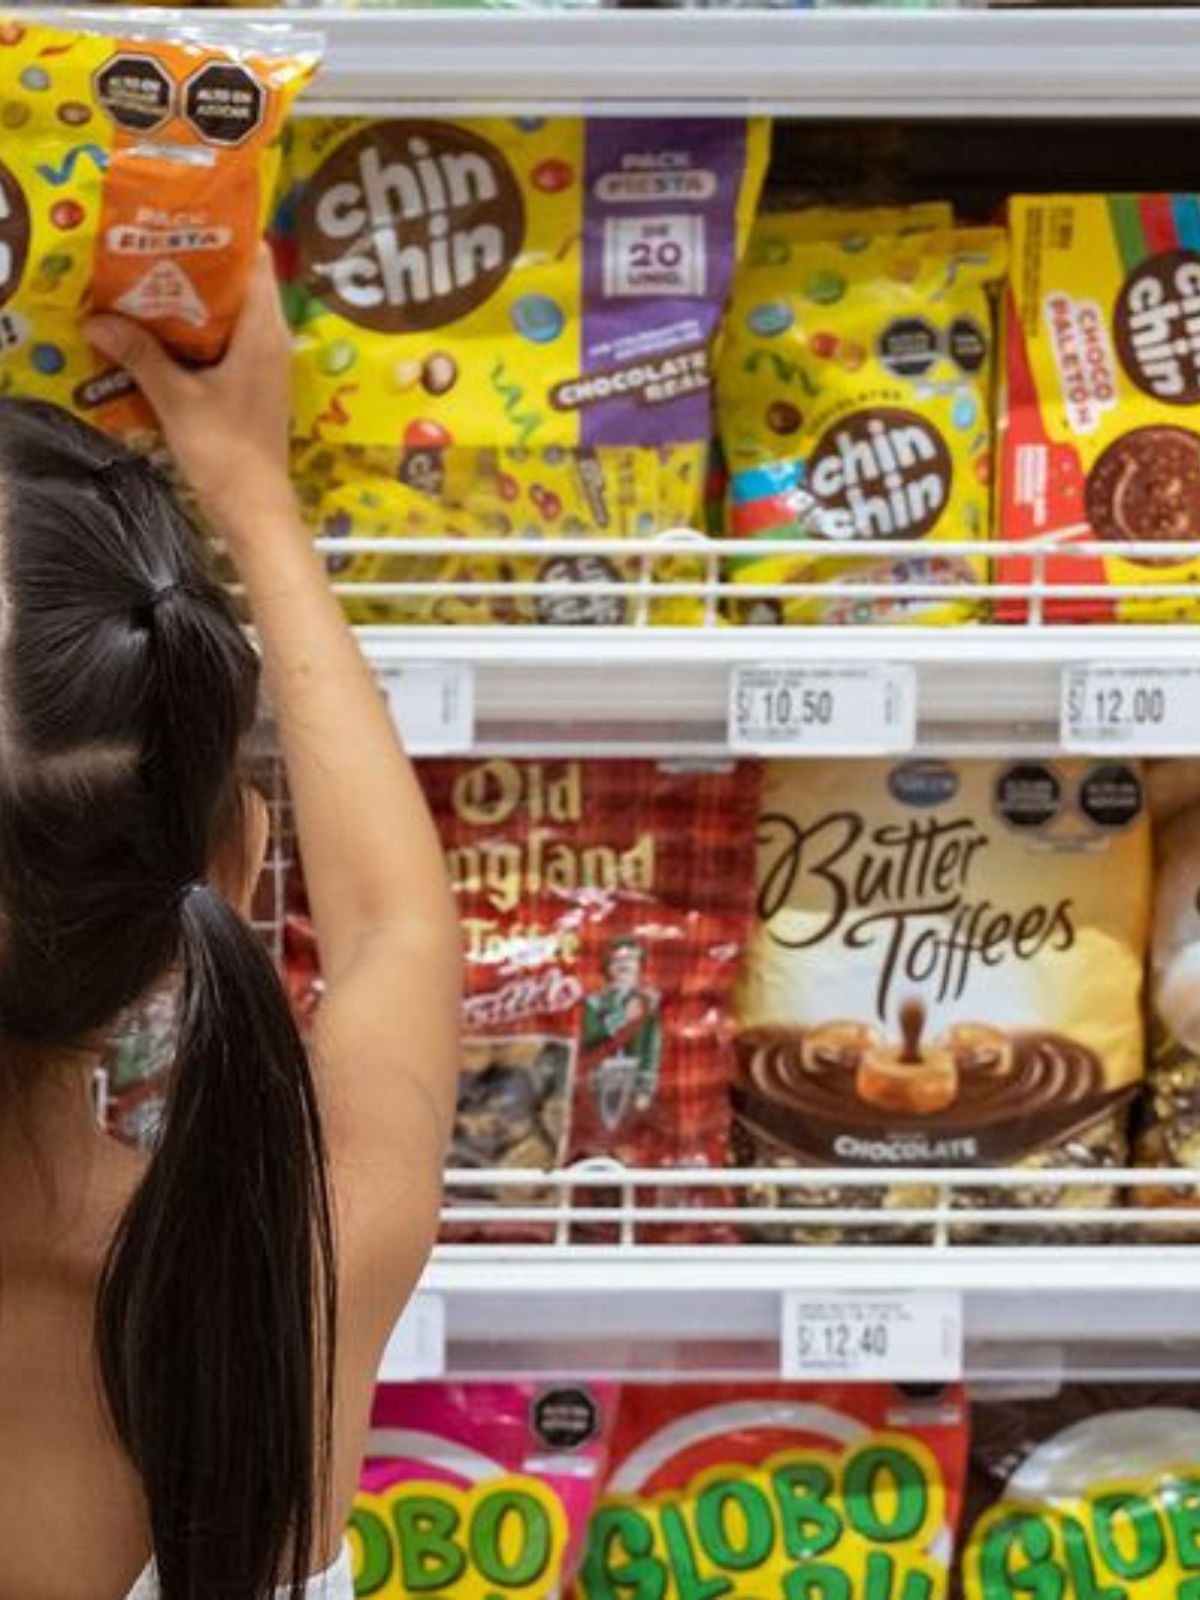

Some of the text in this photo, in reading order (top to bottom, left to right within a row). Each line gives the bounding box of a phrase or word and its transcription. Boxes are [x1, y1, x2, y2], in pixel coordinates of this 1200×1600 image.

[315, 137, 499, 239] chin
[117, 229, 220, 251] FIESTA
[332, 212, 505, 307] chin
[628, 240, 683, 268] 20
[1128, 274, 1190, 397] chin
[557, 350, 707, 405] CHOCOLATE
[811, 419, 937, 498] chin
[816, 472, 944, 541] chin
[763, 688, 834, 726] 10.50
[1095, 687, 1166, 726] 12.00
[452, 758, 583, 824] Old
[447, 828, 656, 911] ngland
[758, 810, 989, 950] Butter
[843, 896, 1076, 1022] Toffees
[833, 1134, 978, 1162] CHOCOLATE
[823, 1322, 888, 1358] 12.40
[581, 1445, 930, 1600] GLOBO
